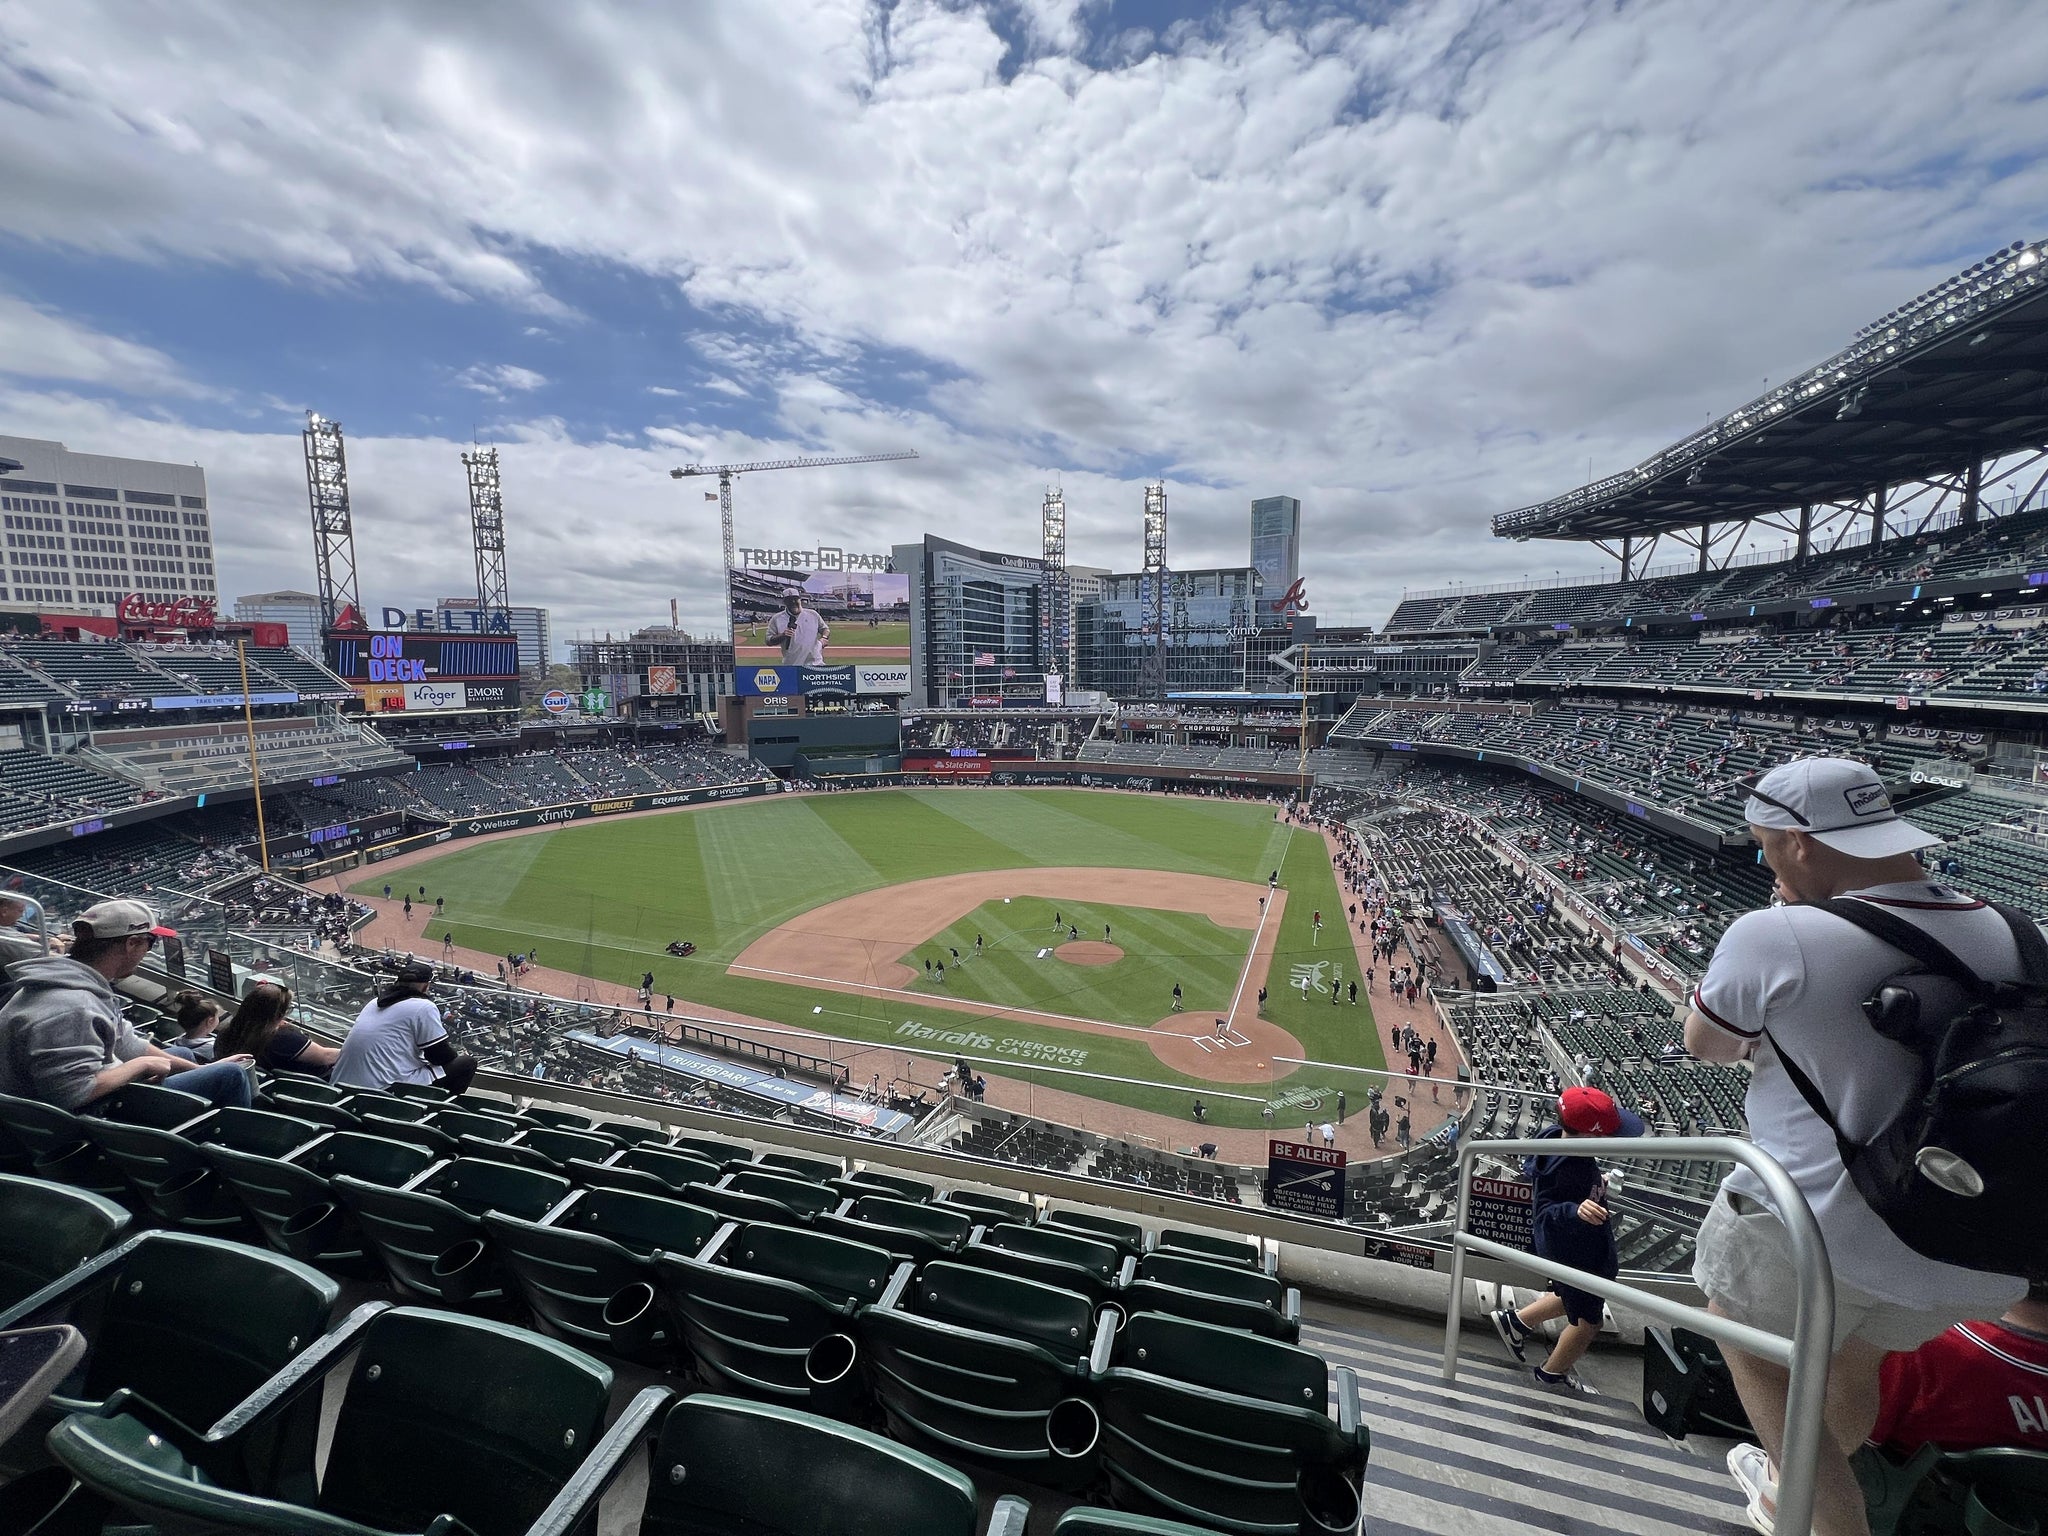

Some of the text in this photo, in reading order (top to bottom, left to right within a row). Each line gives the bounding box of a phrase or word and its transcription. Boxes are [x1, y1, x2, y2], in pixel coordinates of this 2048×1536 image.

[738, 548, 898, 571] TRUIST PARK
[119, 592, 217, 628] Coca-Cola
[382, 606, 513, 632] DELTA
[1225, 625, 1263, 638] xfinity
[370, 635, 403, 658] ON
[368, 659, 428, 682] DECK
[864, 672, 908, 681] COOLRAY
[758, 675, 777, 686] NAPA
[414, 686, 457, 706] Kroger
[467, 687, 505, 697] EMORY
[544, 697, 569, 706] Gulf
[763, 697, 788, 705] ORIS
[950, 749, 961, 757] ON
[961, 749, 978, 757] DECK
[1924, 775, 1964, 788] LEXUS
[719, 787, 749, 795] HYUNDAI
[591, 800, 635, 812] QUIKRETE
[651, 795, 690, 806] EQUIFAX
[536, 807, 576, 823] xfinity
[382, 826, 401, 837] MLB+
[482, 818, 520, 830] Wellstar
[310, 829, 324, 845] ON
[324, 825, 348, 841] DECK
[292, 847, 315, 859] MLB+
[894, 1020, 996, 1050] Harrah's
[995, 1046, 1084, 1066] CASINOS
[1001, 1038, 1089, 1059] CHEROKEE
[668, 1055, 707, 1070] TRUIST
[718, 1070, 751, 1084] PARK
[1267, 1092, 1311, 1109] OPENING
[1308, 1086, 1337, 1099] WEEK
[1275, 1143, 1340, 1165] BE ALERT
[1273, 1188, 1337, 1205] OBJECTS MAY LEAVE
[1472, 1180, 1533, 1200] CAUTIO
[1277, 1200, 1292, 1208] MAY
[1293, 1203, 1315, 1212] CAUSE
[1315, 1206, 1338, 1216] INJURY
[1288, 1195, 1316, 1206] PLAYING
[1316, 1200, 1336, 1210] FIELD
[1468, 1200, 1533, 1216] DO NOT SIT O
[1469, 1208, 1534, 1226] LEAN OVER O
[1475, 1228, 1532, 1244] ON RAILING
[1499, 1223, 1535, 1235] OBJECT
[1396, 1243, 1431, 1256] CAUTION
[1496, 1241, 1528, 1252] EDGE
[1392, 1255, 1433, 1268] YOUR STEP
[1399, 1251, 1425, 1262] WATCH
